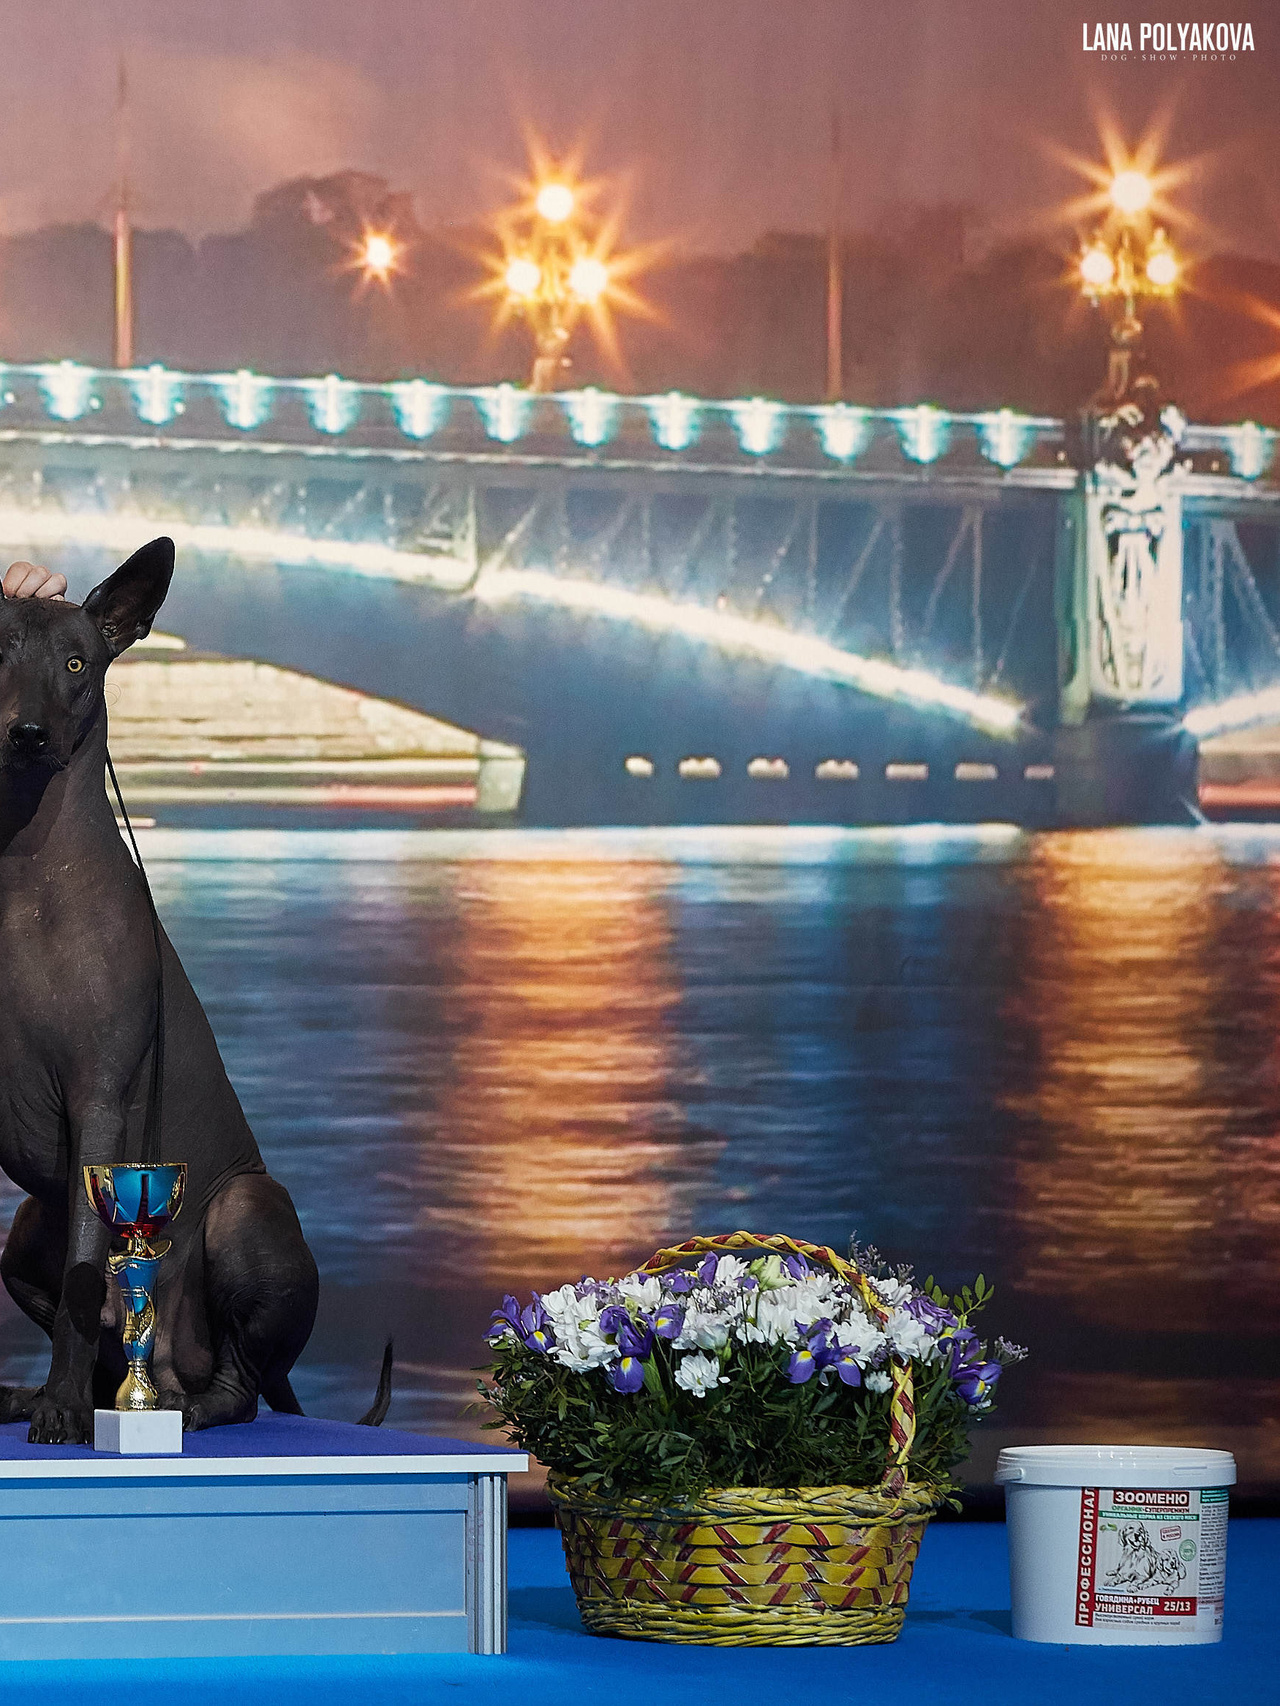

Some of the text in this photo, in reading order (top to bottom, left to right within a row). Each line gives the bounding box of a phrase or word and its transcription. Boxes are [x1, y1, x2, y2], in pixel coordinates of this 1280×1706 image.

[1115, 1491, 1188, 1504] ЗООМЕНЮ
[1077, 1488, 1095, 1625] ПРОФЕССИОНАЛ
[1095, 1602, 1153, 1615] УНИВЕРСАЛ
[1163, 1601, 1191, 1612] 25/13
